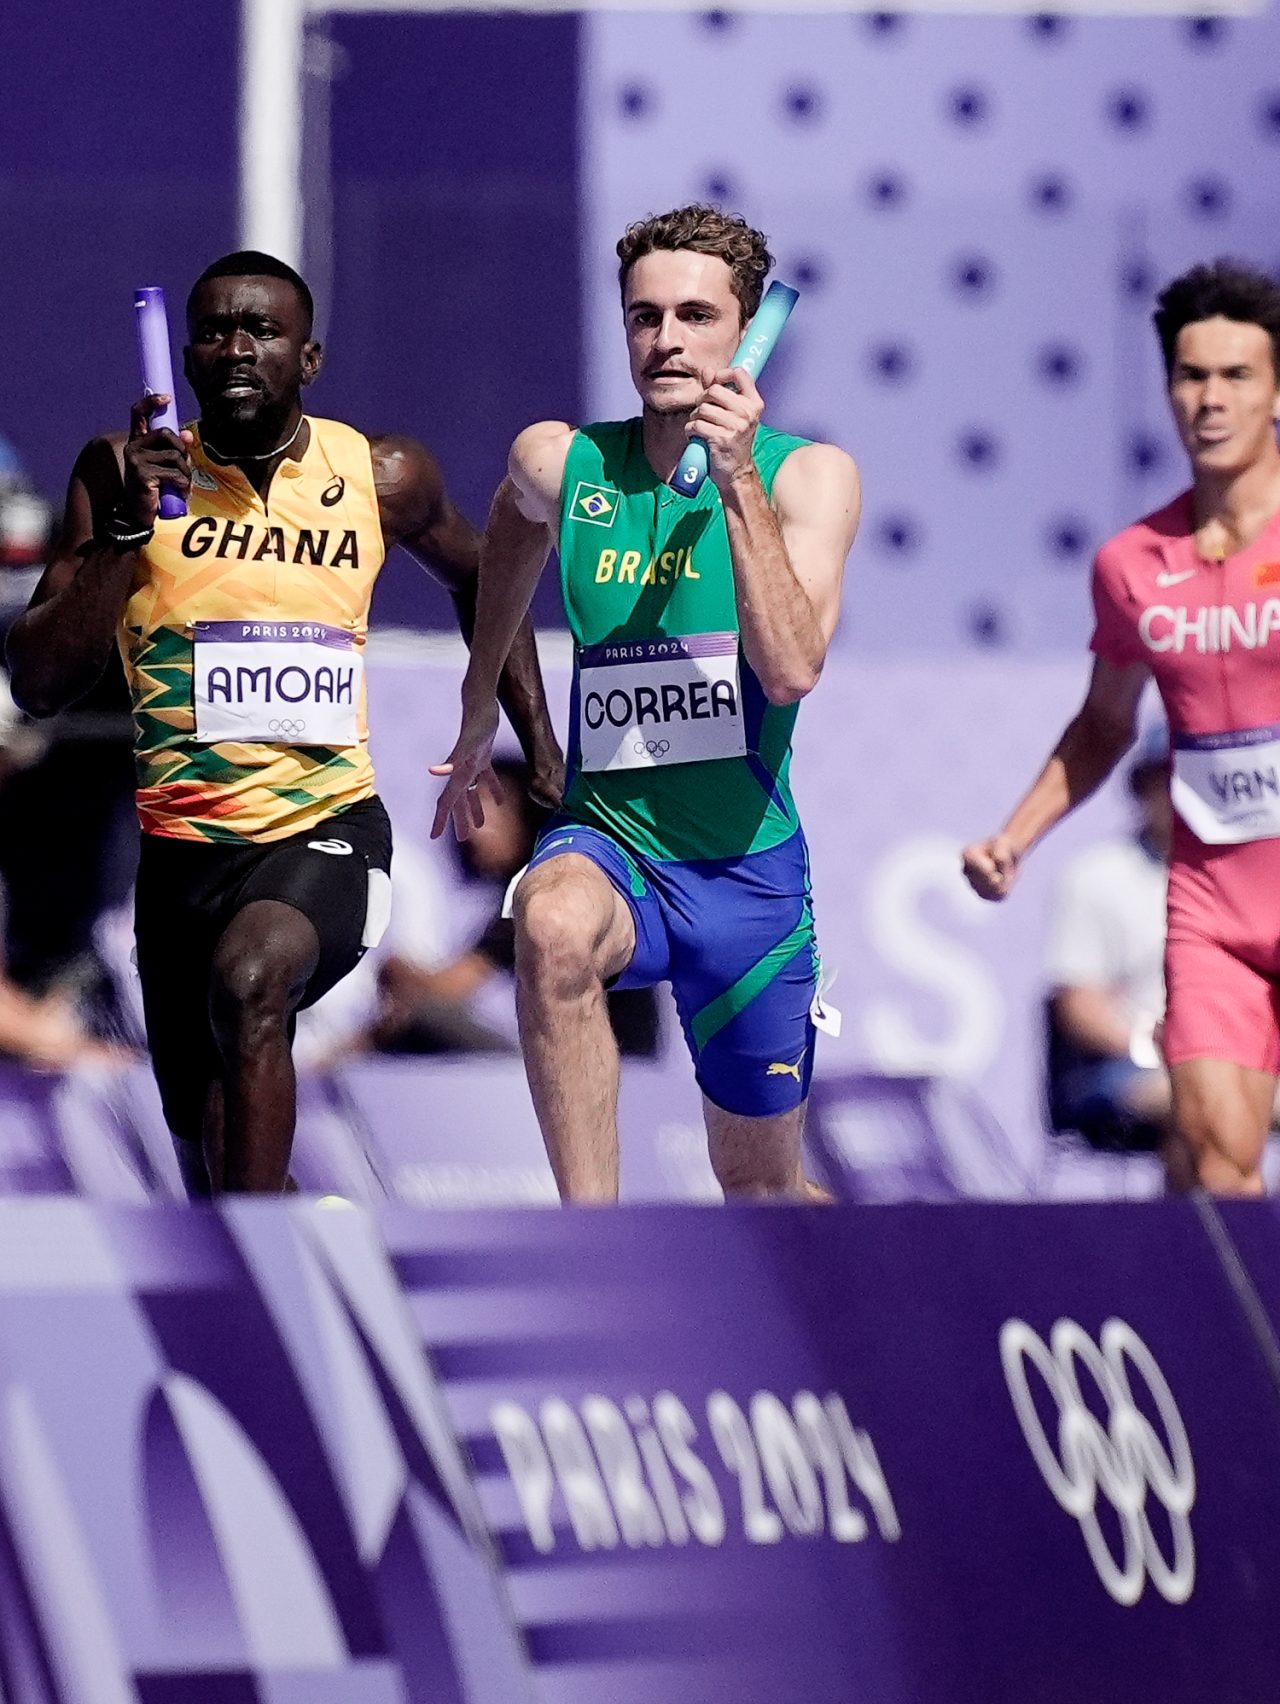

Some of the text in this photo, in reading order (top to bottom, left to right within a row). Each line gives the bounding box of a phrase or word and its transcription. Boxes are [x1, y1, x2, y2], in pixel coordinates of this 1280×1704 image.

[683, 466, 699, 484] 3
[181, 516, 360, 570] GHANA
[595, 546, 701, 586] BRASIL
[241, 625, 328, 641] PARIS 2024
[605, 641, 690, 660] PARIS 2024
[207, 665, 354, 705] AMOAH
[584, 679, 738, 730] CORREA
[1208, 766, 1280, 801] VAN
[706, 1389, 901, 1547] 2024
